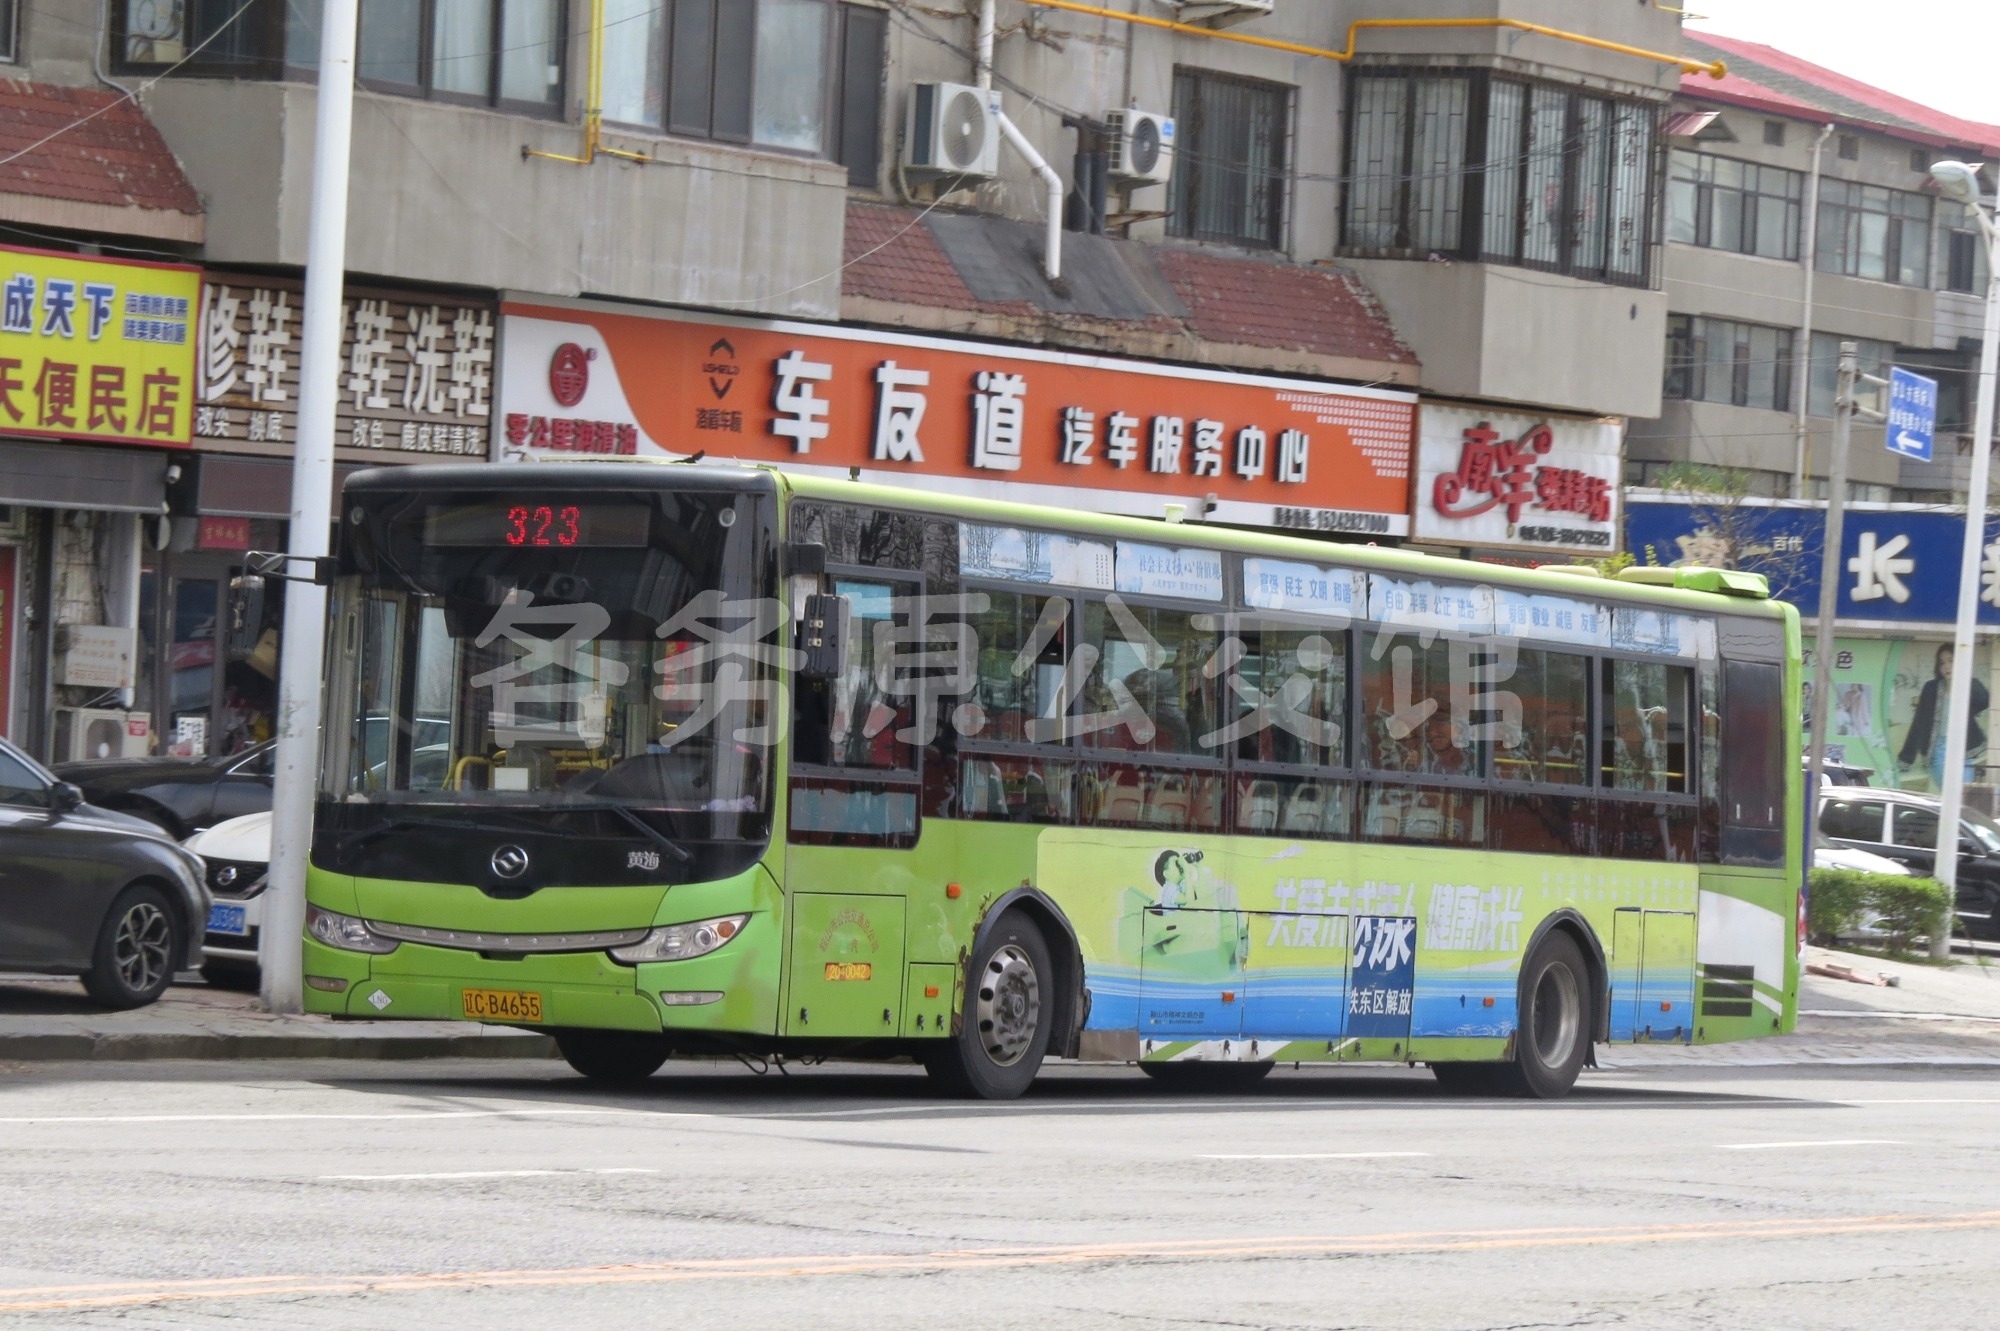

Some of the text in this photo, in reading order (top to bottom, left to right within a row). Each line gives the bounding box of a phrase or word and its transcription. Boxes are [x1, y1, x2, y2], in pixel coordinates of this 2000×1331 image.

[2, 272, 116, 341] 成天下
[201, 283, 494, 417] 修鞋鞋洗鞋
[770, 350, 1310, 484] 车友道 汽车服务中心
[401, 421, 481, 455] 鹿皮鞋清洗
[505, 505, 581, 546] 323
[1139, 554, 1222, 580] 社会主义核心价值观
[1260, 573, 1352, 603] 富强 民主 文明 和谐
[1386, 590, 1475, 619] 自由 平等 公正 法治
[1509, 604, 1598, 633] 爱国 敬业 诚信 友善
[628, 851, 660, 870] 黄海
[1424, 883, 1524, 952] 健康成长
